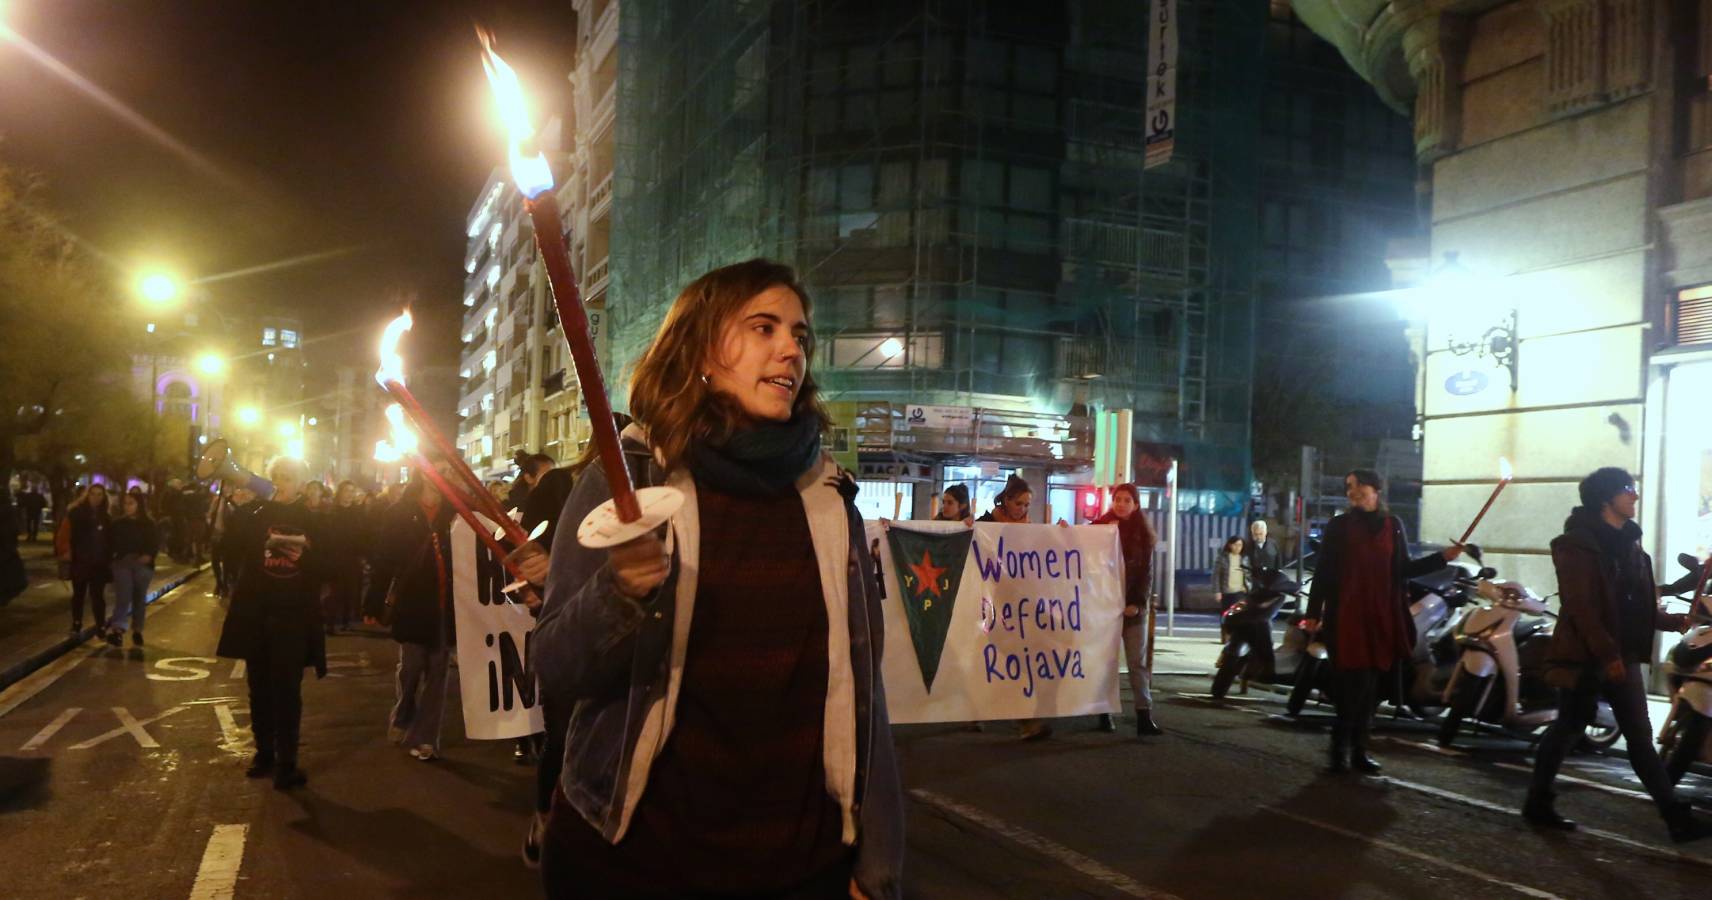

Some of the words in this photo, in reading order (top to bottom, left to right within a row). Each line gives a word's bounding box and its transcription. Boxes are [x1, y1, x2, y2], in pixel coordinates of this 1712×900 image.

[972, 536, 1082, 582] Women
[981, 585, 1081, 639] Defend
[984, 644, 1085, 697] Rojava
